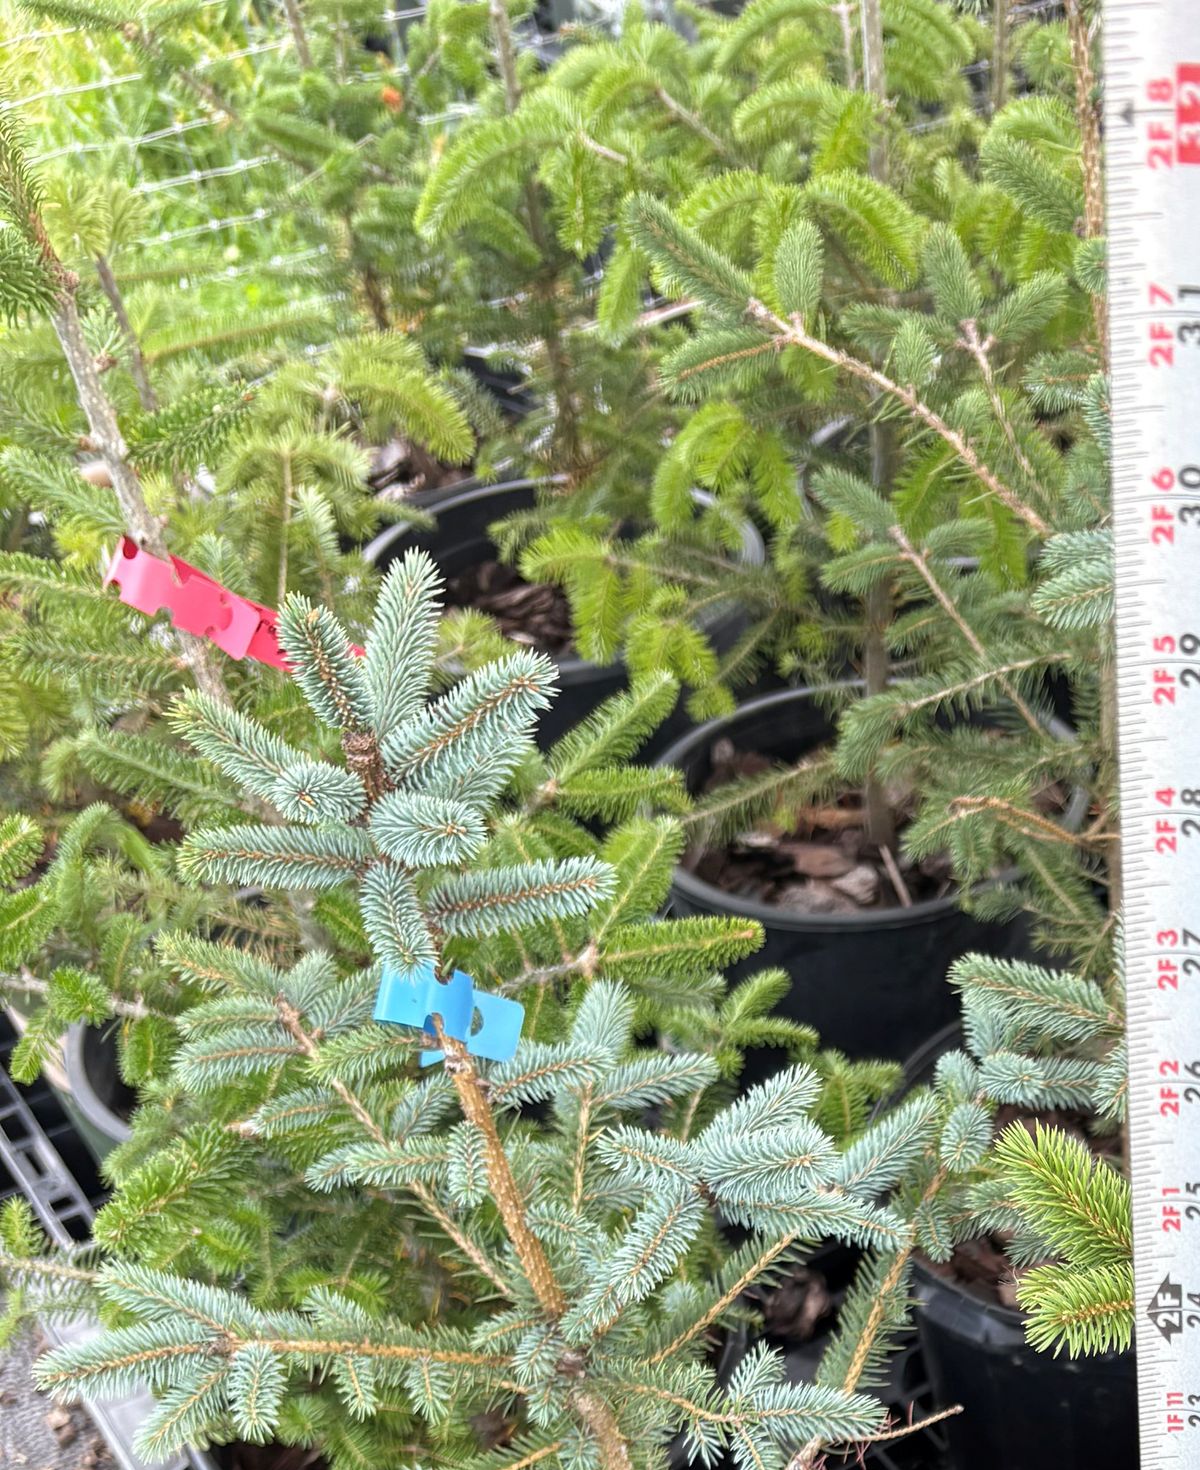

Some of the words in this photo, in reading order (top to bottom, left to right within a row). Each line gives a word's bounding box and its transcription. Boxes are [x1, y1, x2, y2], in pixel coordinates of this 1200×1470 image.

[1148, 283, 1173, 305] 7
[1148, 323, 1175, 367] 2F
[1151, 467, 1175, 491] 6
[1151, 506, 1175, 545] 2F
[1153, 634, 1176, 653] 5
[1153, 669, 1176, 705] 2F
[1155, 787, 1176, 807] 4
[1155, 820, 1177, 854] 2F
[1156, 929, 1178, 947] 3
[1157, 959, 1178, 991] 2F
[1159, 1060, 1179, 1075] 2
[1160, 1087, 1180, 1117] 2F
[1162, 1187, 1180, 1197] 1
[1162, 1206, 1181, 1233] 2F
[1156, 1292, 1180, 1330] 2F
[1167, 1392, 1183, 1406] 11
[1167, 1415, 1184, 1432] 1F
